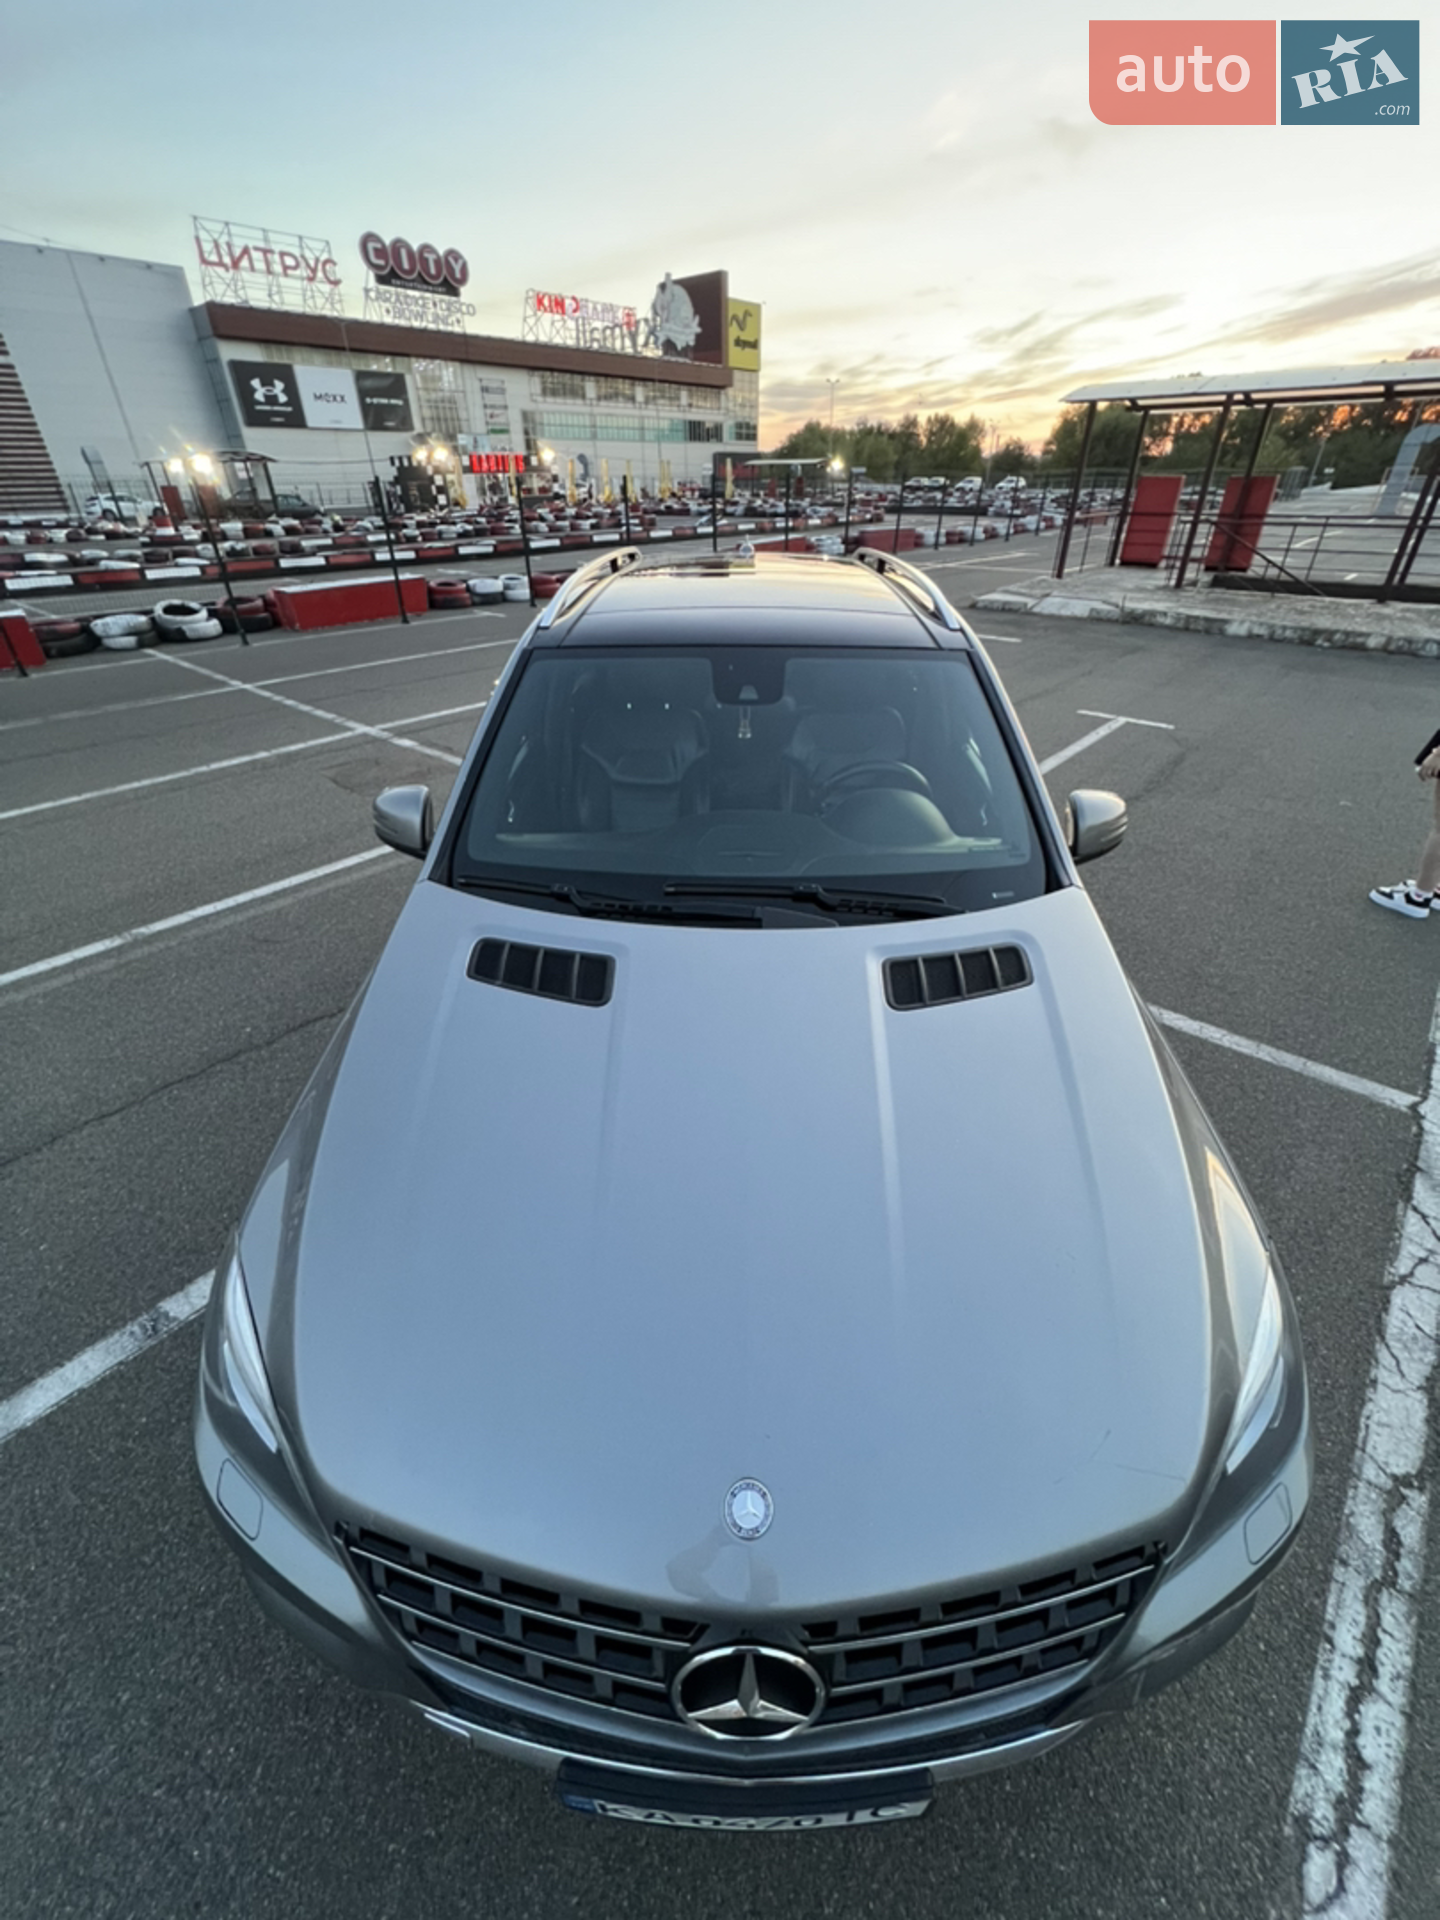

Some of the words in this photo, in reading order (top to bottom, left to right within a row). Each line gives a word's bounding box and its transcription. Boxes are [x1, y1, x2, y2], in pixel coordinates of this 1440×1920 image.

[194, 235, 342, 287] ЦИТРУС
[364, 240, 465, 280] CITY
[392, 305, 454, 327] BOWLING
[439, 298, 476, 317] DISCO
